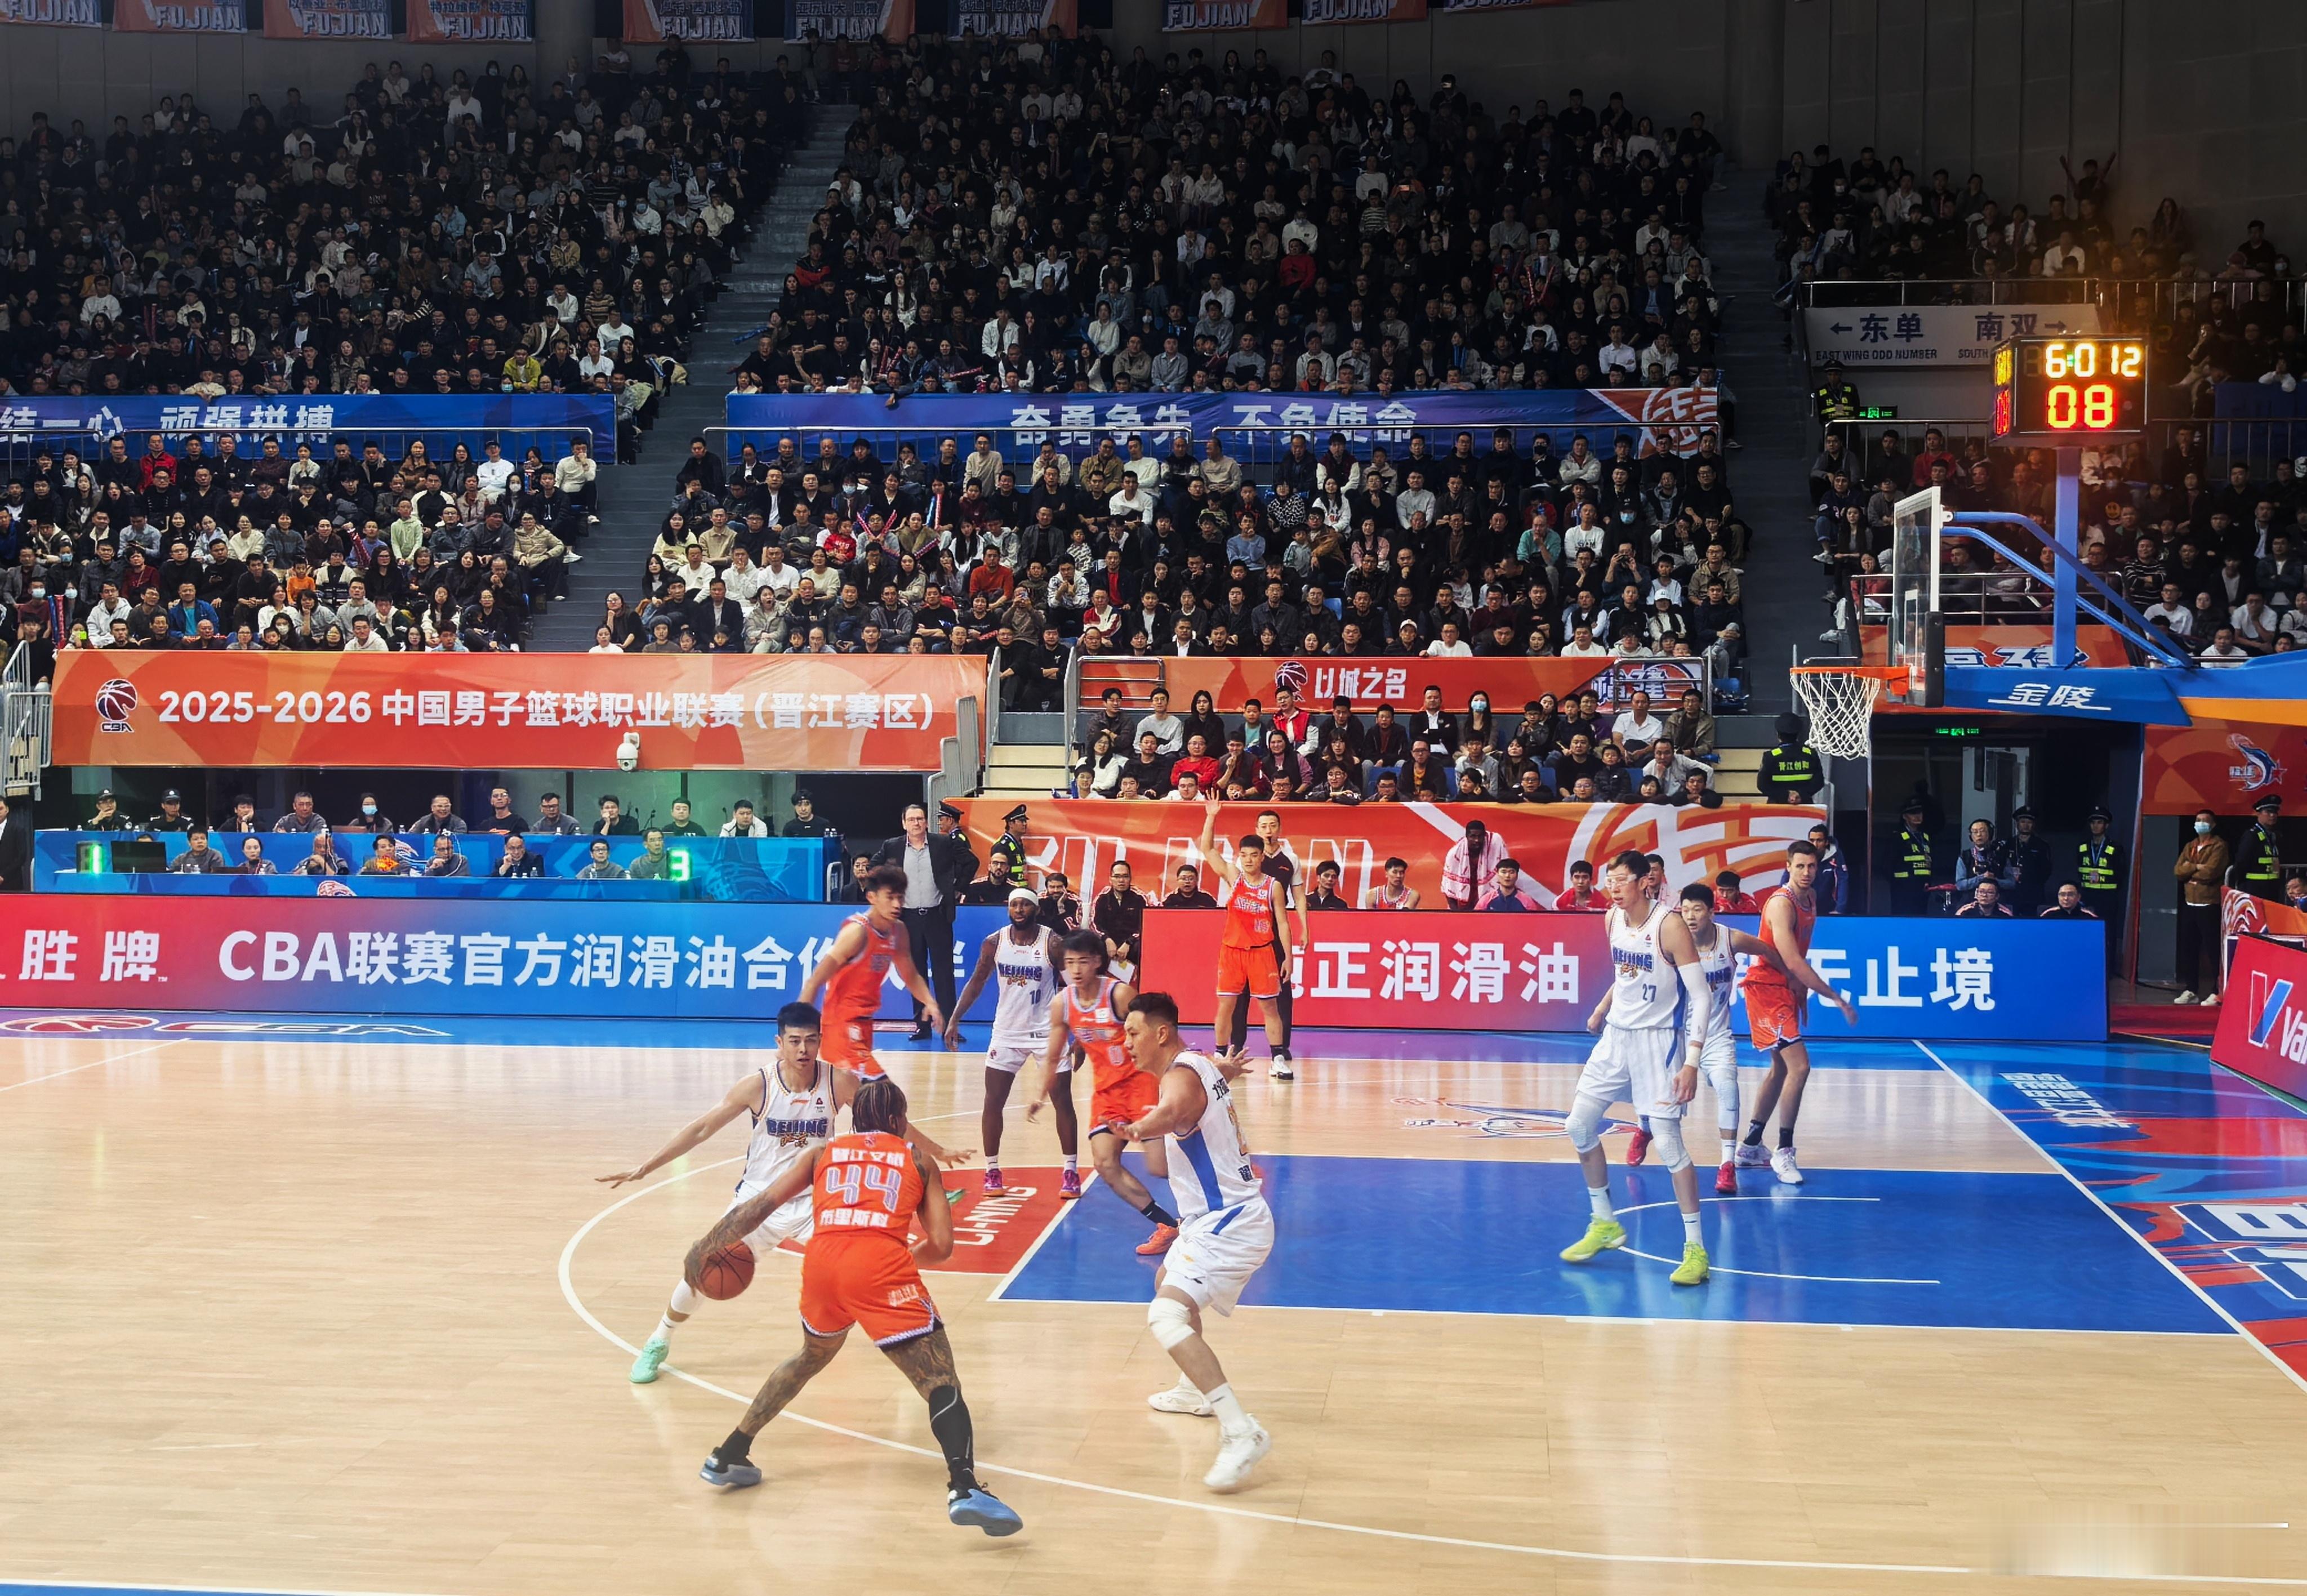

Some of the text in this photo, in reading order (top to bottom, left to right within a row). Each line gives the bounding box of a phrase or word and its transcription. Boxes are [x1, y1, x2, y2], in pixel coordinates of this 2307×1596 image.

[155, 6, 242, 30] FUJIAN
[301, 12, 388, 36] FUJIAN
[444, 16, 528, 40] FUJIAN
[660, 16, 743, 41] FUJIAN
[959, 14, 1041, 38] FUJIAN
[1167, 4, 1249, 28] FUJIAN
[795, 17, 879, 41] FUJIAN
[1860, 313, 1923, 344] 东单
[1976, 311, 2037, 342] 南双
[1816, 348, 1938, 362] EAST WING ODD NUMBER
[1958, 347, 1989, 359] SOUTH
[2047, 385, 2113, 429] 08
[0, 404, 335, 445] 结一心 顽强拼搏
[1012, 402, 1417, 447] 奋勇争先 不负使命
[1315, 666, 1407, 700] 以城之名
[159, 690, 372, 723] 2025-2026
[1988, 683, 2112, 711] 金陵
[100, 722, 134, 733] CBA
[672, 851, 688, 880] 3
[19, 930, 160, 982] 胜牌
[219, 930, 965, 991] CBA联赛官方润滑油合
[1613, 947, 1653, 972] BEIJING
[998, 962, 1041, 981] BEIJING
[1030, 989, 1041, 1005] 10
[1642, 983, 1656, 1002] 27
[767, 1118, 828, 1138] BEIJING
[826, 1164, 901, 1212] 44
[820, 1208, 889, 1228] 布里斯科
[953, 1186, 1037, 1246] LI-NING
